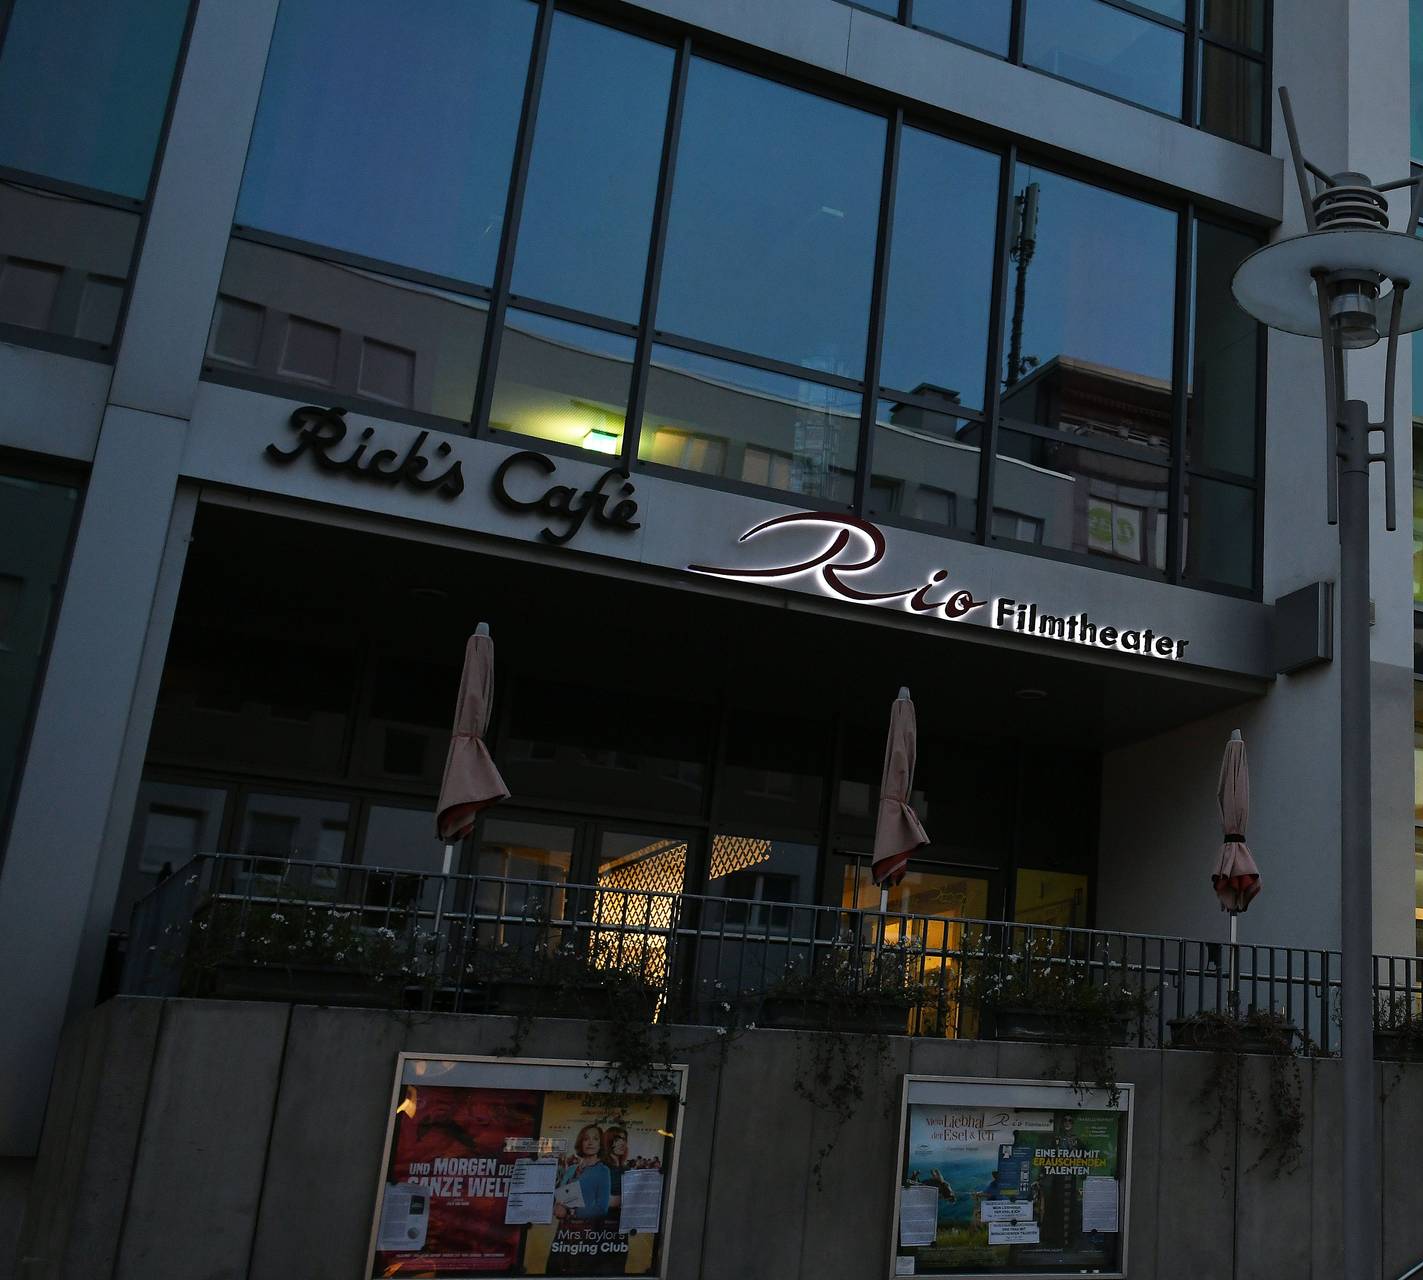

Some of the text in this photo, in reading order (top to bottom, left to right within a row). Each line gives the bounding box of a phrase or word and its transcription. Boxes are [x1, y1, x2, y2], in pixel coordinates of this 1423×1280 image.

[266, 406, 641, 544] Rick's Café
[688, 511, 1189, 660] Rio Filmtheater
[944, 1113, 985, 1129] Liebha
[944, 1130, 968, 1141] Esel
[1035, 1149, 1100, 1158] EINE FRAU MIT
[409, 1162, 430, 1176] UND
[433, 1158, 497, 1176] MORGEN
[1033, 1157, 1106, 1167] ERAUSCHENDEN
[1044, 1166, 1089, 1175] TALENTEN
[467, 1178, 512, 1197] WELT
[583, 1229, 625, 1243] Taylors
[551, 1242, 628, 1255] Singing Club
